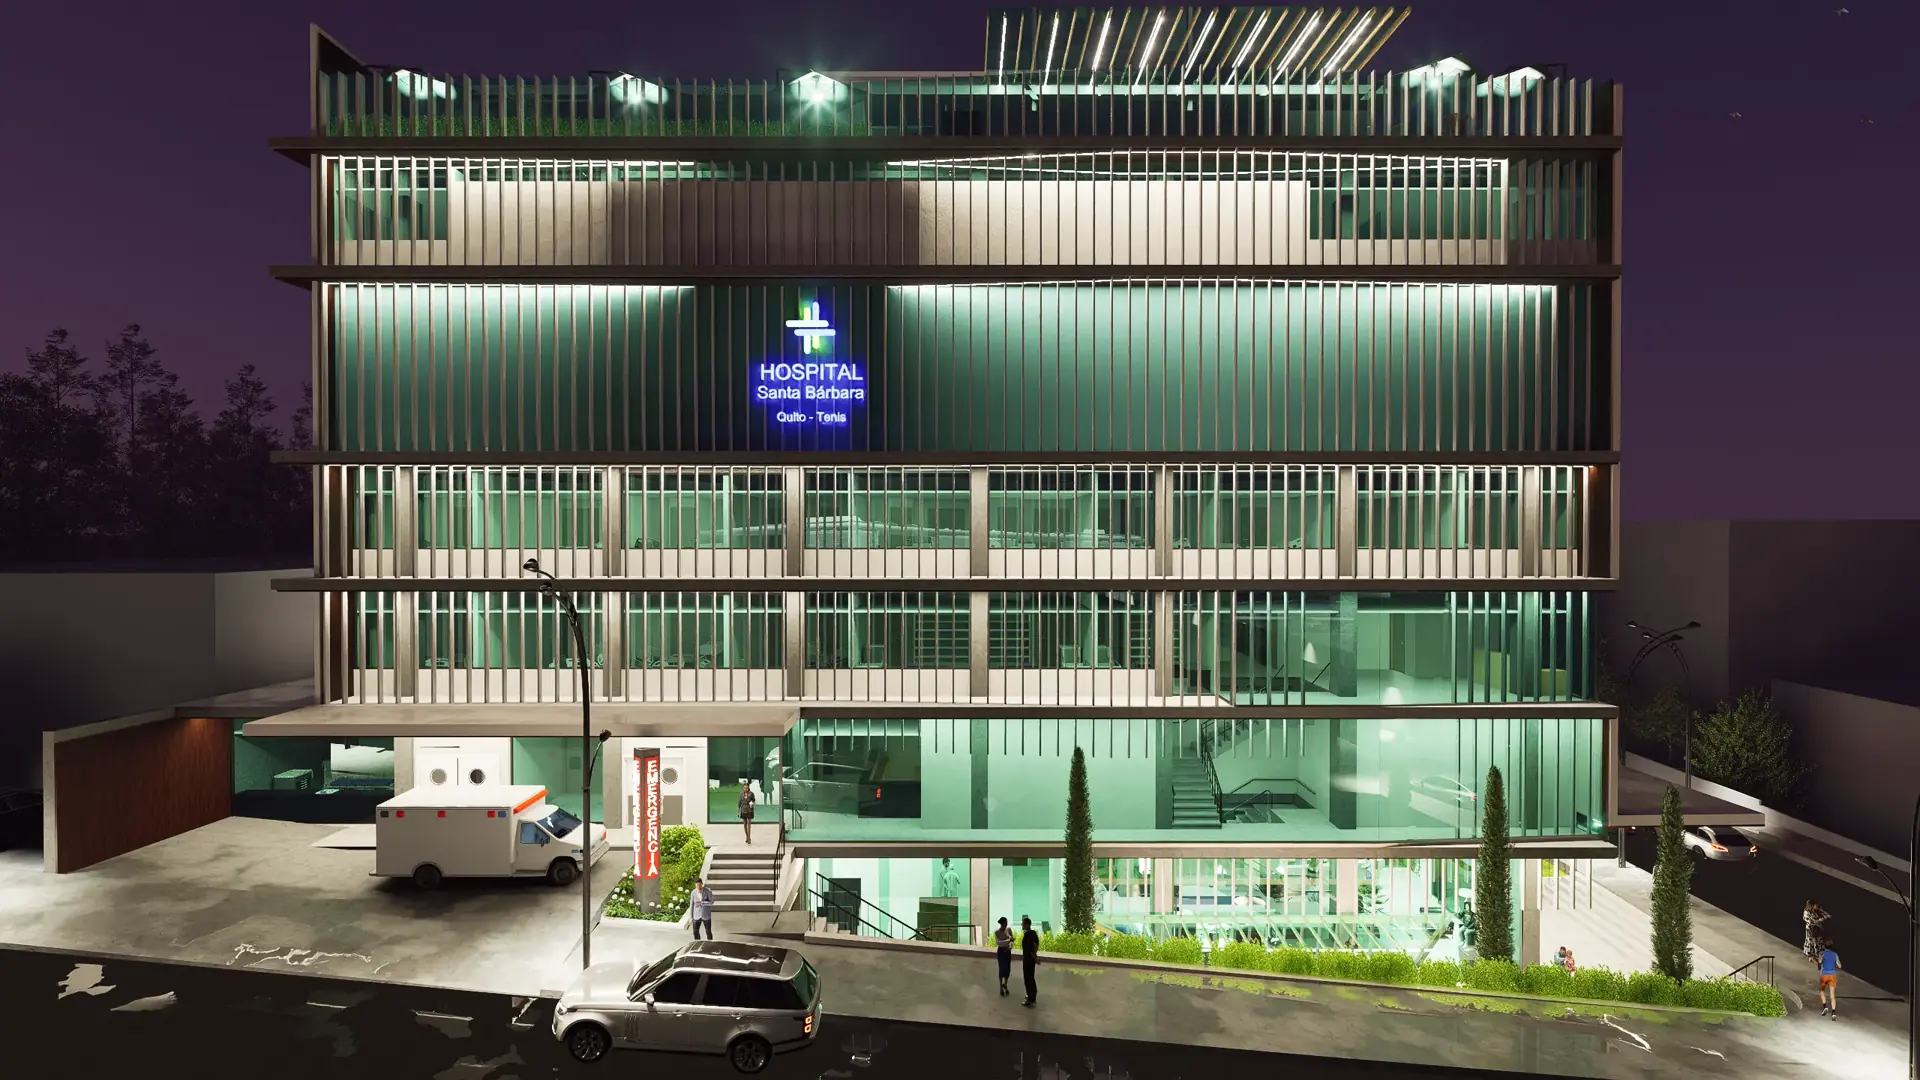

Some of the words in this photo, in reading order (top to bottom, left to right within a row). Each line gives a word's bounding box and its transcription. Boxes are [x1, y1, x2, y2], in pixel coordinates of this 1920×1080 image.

[760, 363, 863, 380] HOSPITAL
[757, 385, 800, 399] Santa
[805, 385, 864, 399] Bárbara
[776, 411, 806, 422] Quito
[816, 411, 847, 422] Tenis
[647, 760, 658, 876] EMERGENCIA
